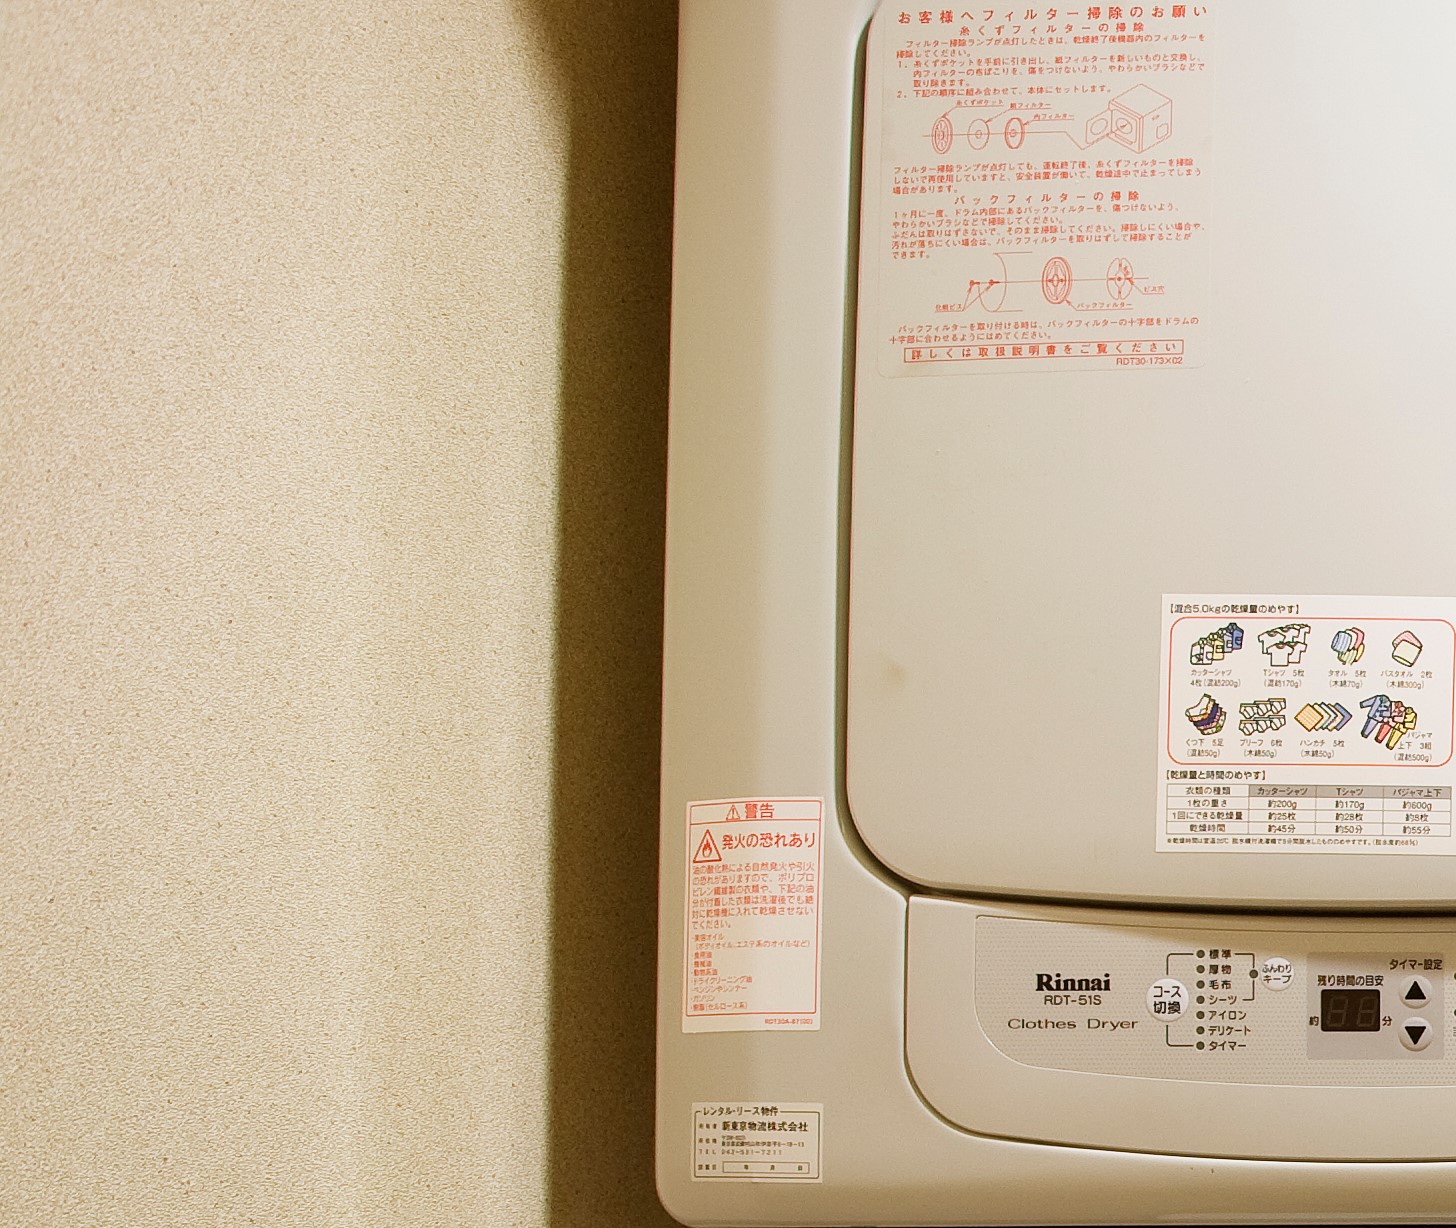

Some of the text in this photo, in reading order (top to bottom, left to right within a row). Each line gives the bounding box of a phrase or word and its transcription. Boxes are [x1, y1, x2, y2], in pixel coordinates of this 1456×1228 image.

[744, 804, 775, 819] 警告
[722, 833, 816, 850] 発火の恐れあり
[1209, 950, 1232, 960] 標準
[1389, 959, 1443, 970] タイマー設定
[1209, 965, 1232, 975] 厚物
[1036, 973, 1111, 992] Rinnai
[1263, 975, 1292, 984] キープ
[1318, 975, 1383, 987] 残り時間の目安
[1209, 980, 1232, 990] 毛布
[1153, 986, 1181, 998] コース
[1044, 995, 1102, 1005] RDT-51S
[1209, 996, 1237, 1005] シーツ
[1153, 1001, 1181, 1015] 切換
[1208, 1011, 1247, 1020] アイロン
[1007, 1019, 1139, 1031] Clothes Dryer
[1208, 1026, 1251, 1036] デリケート
[1209, 1041, 1247, 1051] タイマー
